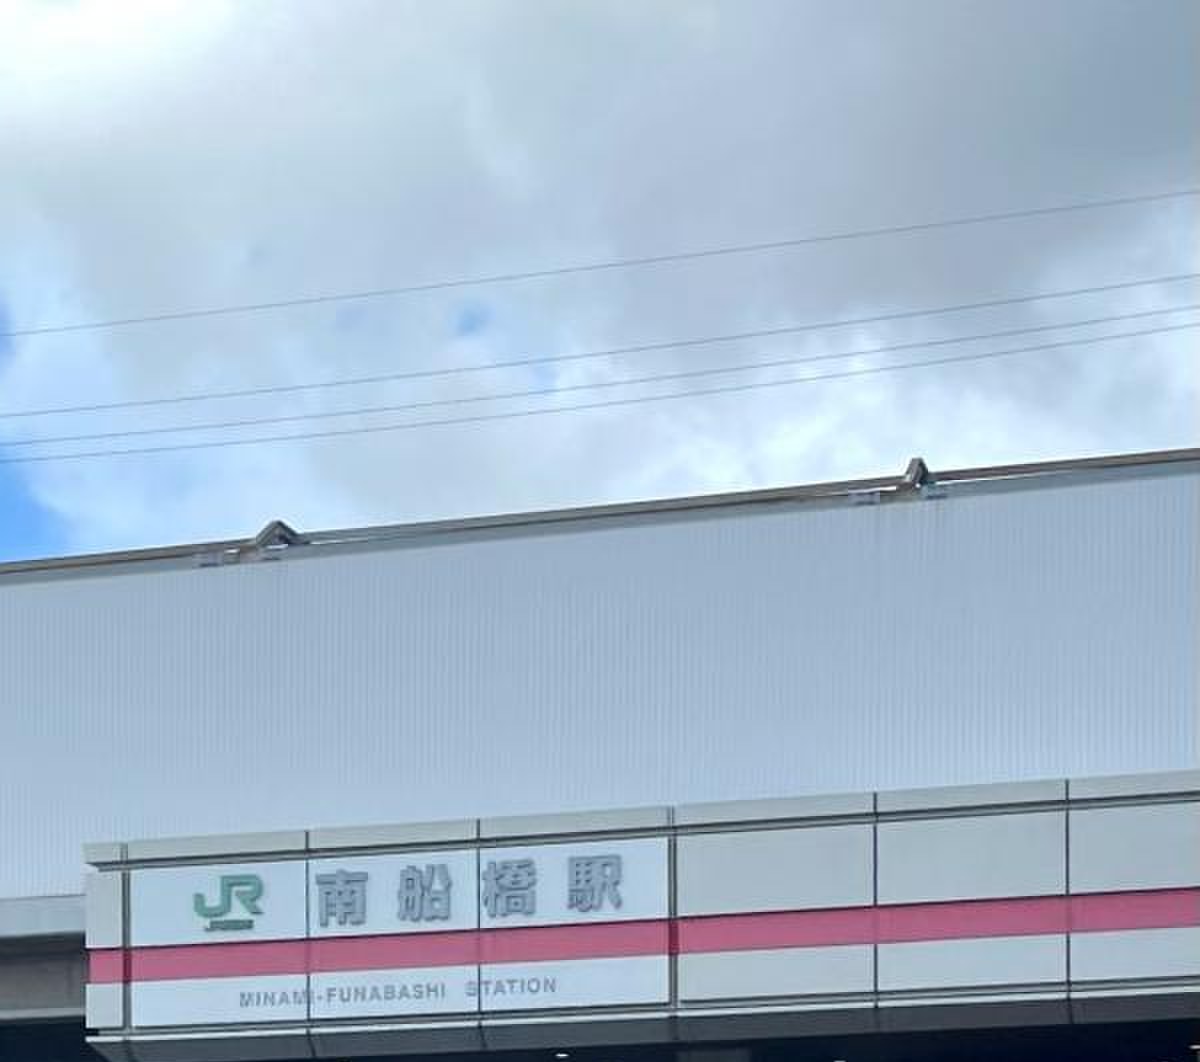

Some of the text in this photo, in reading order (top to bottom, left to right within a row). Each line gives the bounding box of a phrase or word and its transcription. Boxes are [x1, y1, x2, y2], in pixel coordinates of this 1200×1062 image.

[193, 874, 264, 918] JR
[315, 854, 624, 927] 南船橋駅
[240, 976, 557, 1008] MINAMI-FUNABASHI STATION
